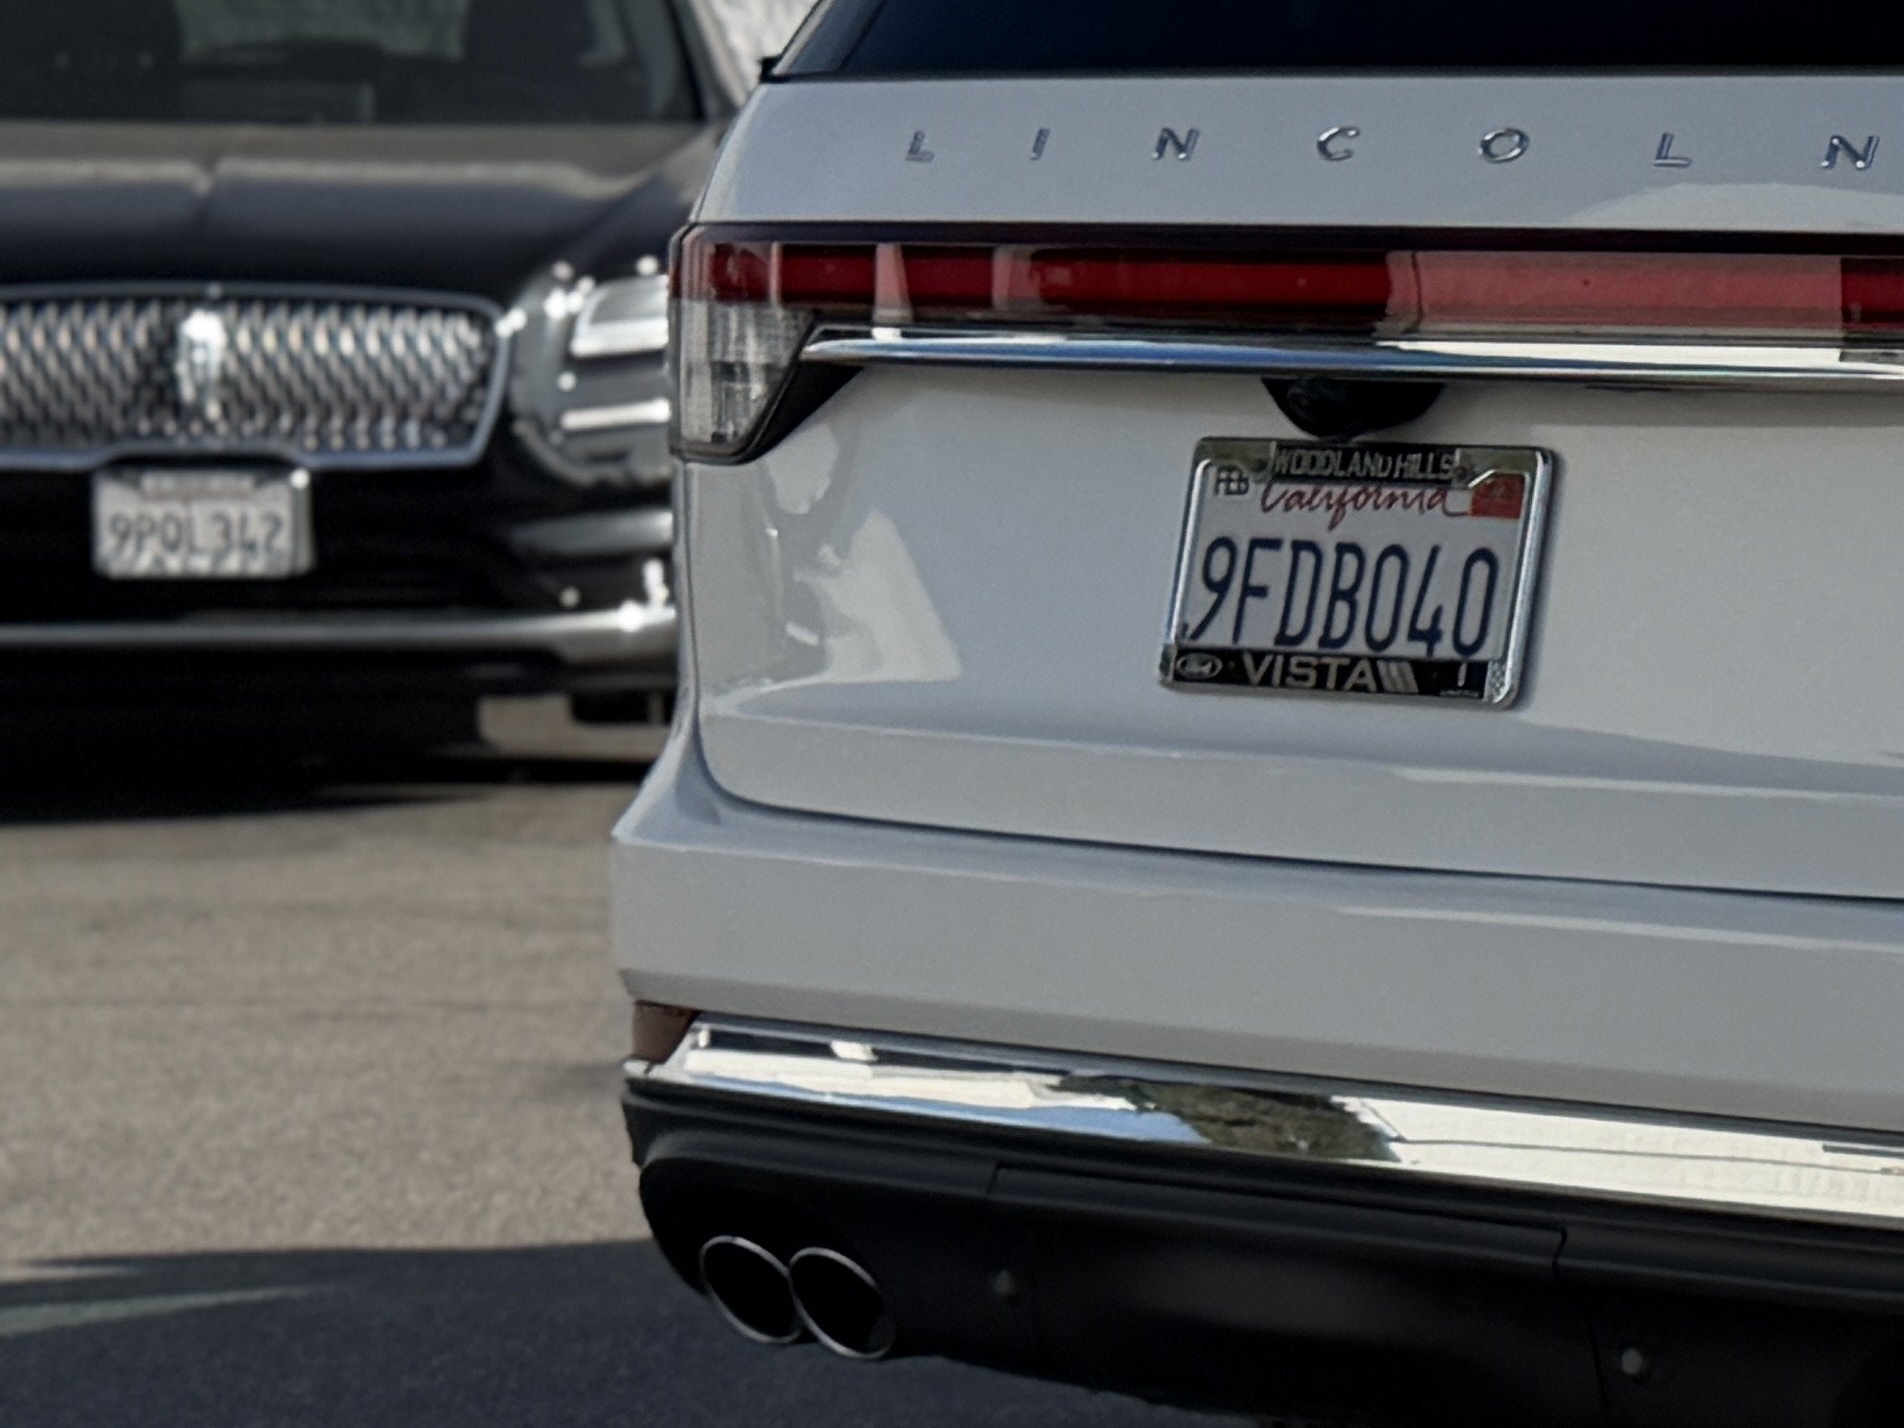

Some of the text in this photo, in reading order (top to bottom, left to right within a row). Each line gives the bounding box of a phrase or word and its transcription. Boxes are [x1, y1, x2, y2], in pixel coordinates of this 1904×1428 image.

[907, 126, 1879, 171] LINCOLN
[1274, 448, 1450, 481] WOODLAND HILLS
[1262, 477, 1469, 530] California
[1189, 537, 1498, 656] 9FDB040
[1243, 652, 1378, 691] VISTA
